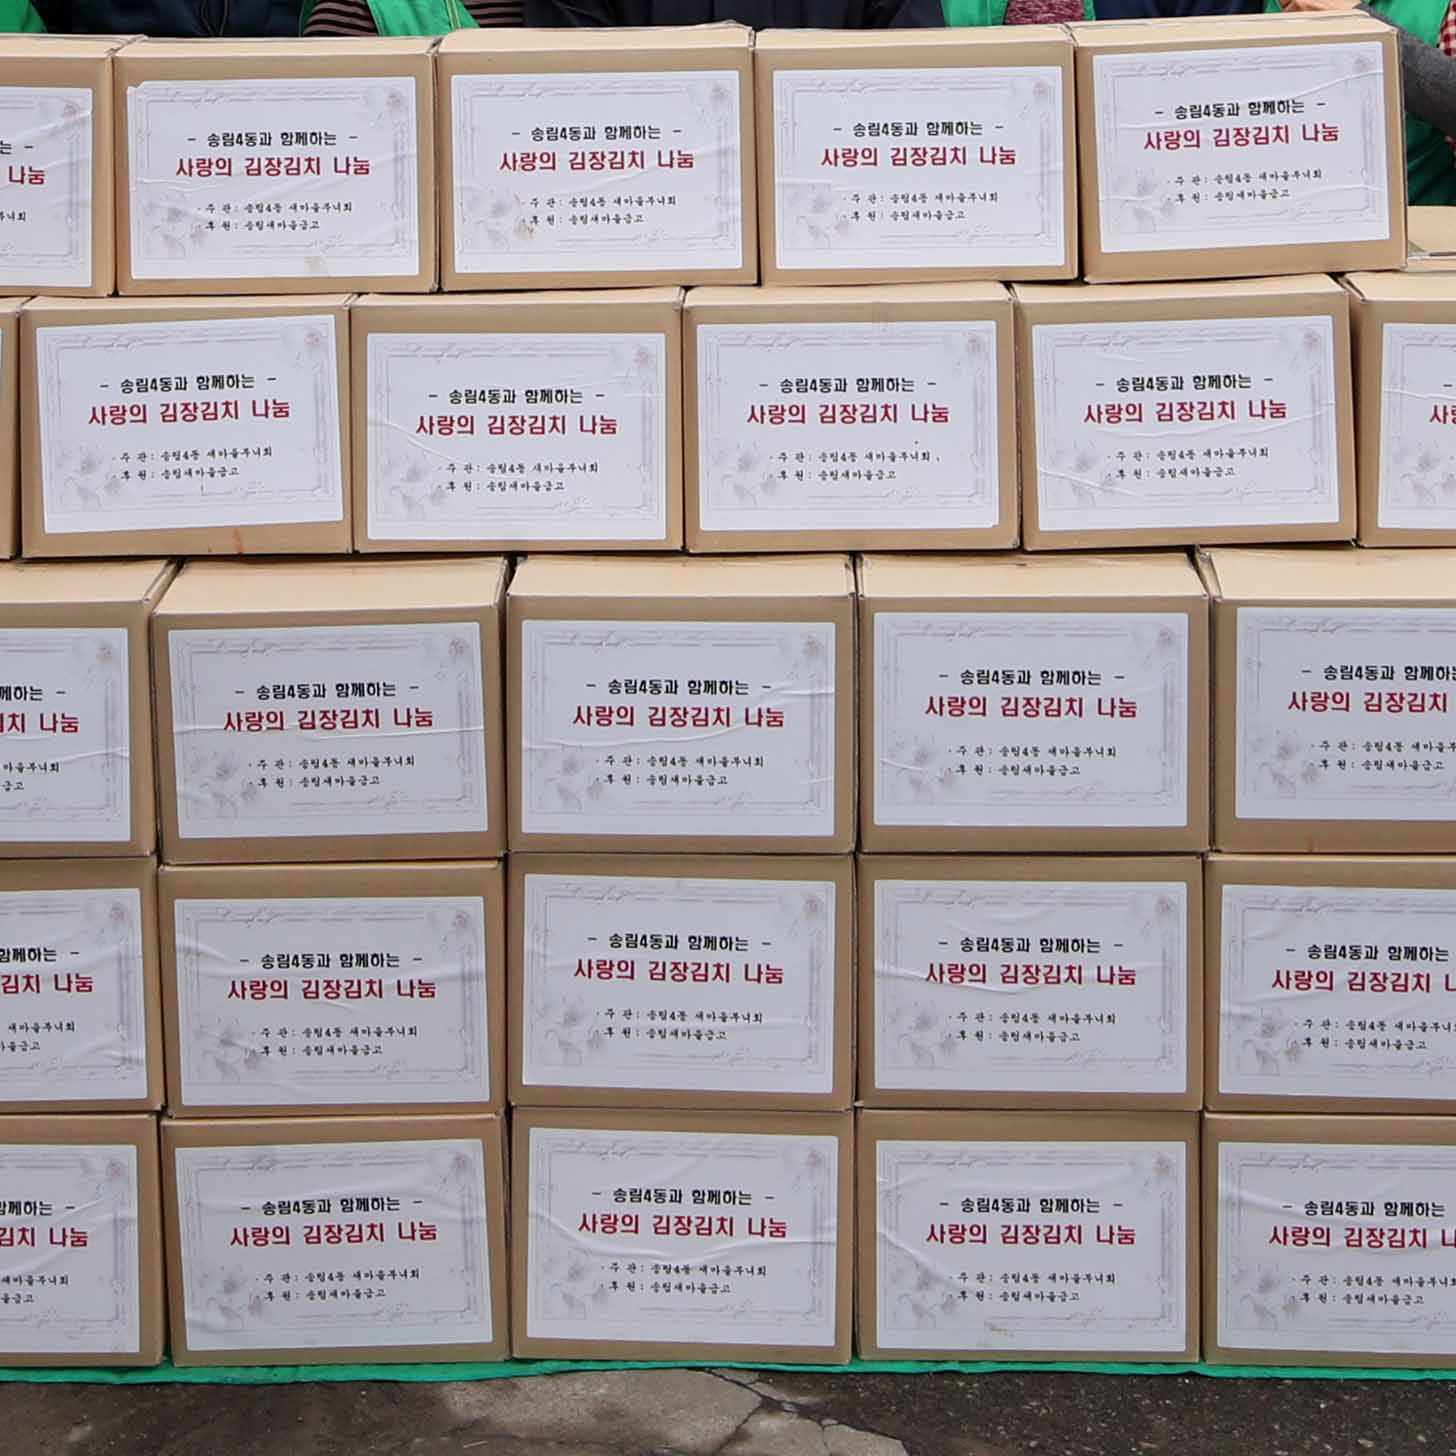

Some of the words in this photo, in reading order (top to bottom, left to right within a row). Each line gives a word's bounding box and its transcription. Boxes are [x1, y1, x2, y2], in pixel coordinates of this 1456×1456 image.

[206, 131, 273, 152] 송림4동과
[277, 130, 337, 149] 함께하는
[852, 120, 920, 142] 송림4동과
[925, 119, 984, 138] 함께하는
[1143, 127, 1201, 153] 사랑의
[1212, 122, 1290, 149] 김장김치
[1301, 121, 1340, 144] 나눔
[175, 156, 233, 180] 사랑의
[243, 154, 321, 179] 김장김치
[333, 155, 371, 178] 나눔
[499, 150, 557, 173] 사랑의
[567, 149, 645, 173] 김장김치
[656, 148, 696, 171] 나눔
[820, 146, 879, 170] 사랑의
[889, 144, 967, 168] 김장김치
[979, 144, 1017, 167] 나눔
[8, 163, 46, 187] 나눔
[779, 376, 849, 395] 송림4동과
[855, 375, 915, 395] 함께하는
[88, 402, 148, 427] 사랑의
[159, 398, 240, 425] 김장김치
[251, 397, 291, 421] 나눔
[746, 402, 807, 427] 사랑의
[818, 401, 902, 426] 김장김치
[910, 401, 950, 425] 나눔
[1083, 401, 1144, 426] 사랑의
[1154, 398, 1236, 424] 김장김치
[1247, 397, 1288, 421] 나눔
[415, 413, 475, 438] 사랑의
[487, 412, 567, 437] 김장김치
[578, 413, 618, 437] 나눔
[1323, 663, 1396, 683] 송림4동과
[924, 694, 988, 719] 사랑의
[999, 694, 1084, 720] 김장김치
[1096, 695, 1138, 720] 나눔
[1287, 689, 1351, 714] 사랑의
[1363, 690, 1449, 715] 김장김치
[39, 710, 80, 735] 나눔
[221, 709, 285, 734] 사랑의
[296, 707, 381, 733] 김장김치
[392, 705, 433, 730] 나눔
[572, 703, 635, 729] 사랑의
[647, 704, 731, 730] 김장김치
[744, 705, 785, 729] 나눔
[1306, 942, 1380, 962] 송림4동과
[1386, 944, 1450, 964] 함께하는
[52, 971, 94, 994] 나눔
[573, 957, 636, 982] 사랑의
[647, 958, 731, 985] 김장김치
[743, 961, 785, 986] 나눔
[923, 961, 988, 988] 사랑의
[999, 961, 1083, 987] 김장김치
[1095, 963, 1137, 987] 나눔
[1271, 968, 1335, 993] 사랑의
[1345, 969, 1431, 995] 김장김치
[227, 975, 289, 1002] 사랑의
[299, 975, 384, 1002] 김장김치
[395, 977, 437, 1000] 나눔
[960, 1196, 1032, 1216] 송림4동과
[1039, 1196, 1101, 1215] 함께하는
[48, 1225, 89, 1249] 나눔
[229, 1224, 291, 1249] 사랑의
[302, 1221, 385, 1247] 김장김치
[397, 1220, 438, 1243] 나눔
[577, 1211, 640, 1237] 사랑의
[651, 1212, 735, 1239] 김장김치
[747, 1216, 788, 1240] 나눔
[925, 1222, 988, 1246] 사랑의
[999, 1222, 1083, 1247] 김장김치
[1095, 1223, 1137, 1247] 나눔
[1269, 1224, 1331, 1249] 사랑의
[1343, 1223, 1428, 1251] 김장김치
